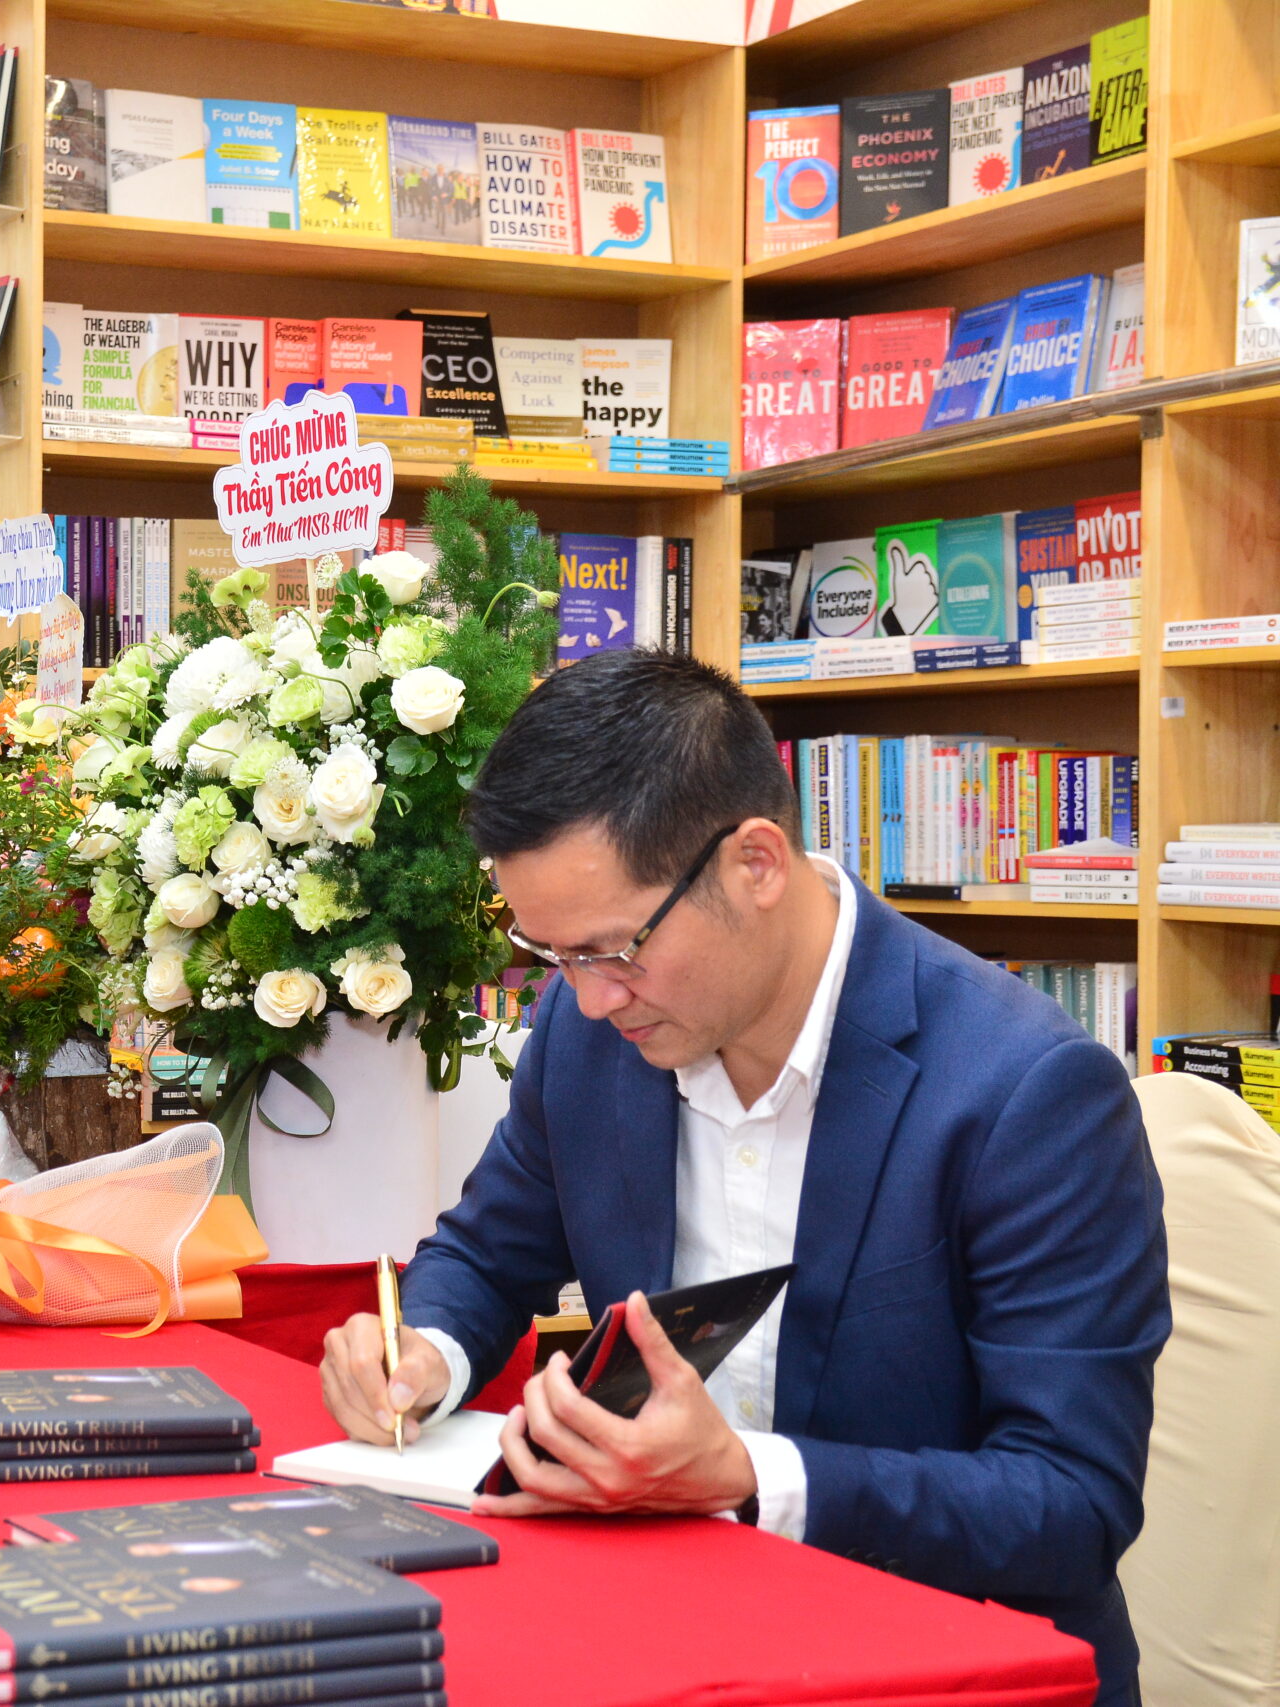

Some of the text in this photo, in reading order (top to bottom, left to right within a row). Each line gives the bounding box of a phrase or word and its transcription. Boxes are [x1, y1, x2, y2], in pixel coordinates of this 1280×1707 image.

[952, 75, 1007, 101] BILL GATES
[1025, 62, 1092, 112] AMAZON
[951, 97, 992, 118] HOW TO
[212, 109, 283, 127] Four Days
[327, 119, 379, 132] Trolls of
[881, 112, 911, 124] THE
[951, 112, 996, 133] THE NEXT
[223, 126, 274, 140] a Week
[763, 121, 790, 140] THE
[858, 128, 934, 147] PHOENIX
[950, 129, 1002, 151] PANDEMIC
[483, 132, 561, 150] BILL GATES
[581, 132, 634, 151] BILL GATES
[765, 138, 820, 160] PERFECT
[485, 154, 563, 178] HOW TO
[581, 148, 662, 169] HOW TO PREVENT
[851, 148, 940, 169] ECONOMY
[45, 158, 79, 181] day
[584, 163, 627, 179] THE NEXT
[487, 176, 565, 200] AVOID A
[583, 177, 634, 196] PANDEMIC
[754, 157, 839, 223] 10
[488, 198, 566, 221] CLIMATE
[304, 219, 383, 232] NATHANIEL
[489, 220, 568, 241] DISASTER
[84, 317, 153, 334] THE ALGEBRA
[275, 322, 317, 334] Careless
[331, 322, 376, 333] Careless
[1114, 316, 1144, 331] BUIL
[83, 334, 140, 349] OF WEALTH
[275, 332, 308, 342] People
[331, 332, 366, 342] People
[83, 349, 130, 364] A SIMPLE
[330, 352, 392, 361] where used
[340, 342, 366, 352] story
[499, 346, 575, 365] Competing
[582, 344, 617, 358] james
[1006, 332, 1081, 376] CHOICE
[83, 365, 133, 379] FORMULA
[185, 339, 258, 389] WHY
[330, 361, 369, 369] to work
[422, 354, 493, 384] CEO
[582, 360, 630, 371] timpson
[861, 358, 932, 373] GOOD TO
[936, 348, 1001, 390] CHOICE
[83, 380, 102, 393] FOR
[511, 371, 562, 385] Against
[582, 376, 624, 396] the
[42, 391, 73, 409] hing
[83, 396, 137, 411] FINANCIAL
[184, 390, 258, 407] WE'RE GETTING
[425, 387, 496, 401] Excellence
[521, 394, 555, 407] Luck
[741, 380, 836, 418] GREAT
[583, 400, 663, 428] happy
[249, 409, 347, 466] CHÚC MỪNG
[222, 456, 381, 517] Thầy Tiến Công
[242, 504, 370, 549] Em Như MSB HCM
[1077, 510, 1141, 557] PIVOT
[188, 548, 233, 557] MASTE
[122, 530, 130, 610] START YOUR OWN CORPORATION
[136, 557, 144, 577] GETTING
[559, 554, 628, 590] Next!
[136, 596, 144, 609] DEBT
[667, 575, 677, 631] DISRUPTION
[816, 588, 872, 605] Everyone
[817, 603, 870, 619] Included
[1059, 760, 1068, 829] UPGRADE
[1073, 760, 1084, 830] UPGRADE
[819, 801, 830, 849] ADHD
[1263, 850, 1280, 859] WRIT
[1183, 1046, 1210, 1057] Business
[1211, 1048, 1228, 1058] Plans
[1184, 1061, 1229, 1078] Accounting
[75, 1420, 145, 1435] TRUTH
[17, 1438, 159, 1456] LIVING TRUTH
[5, 1462, 150, 1482] LIVING TRUTH
[126, 1620, 314, 1657] LIVING TRUTH
[126, 1649, 315, 1688] LIVING TRUTH
[227, 1676, 315, 1706] TRUTH
